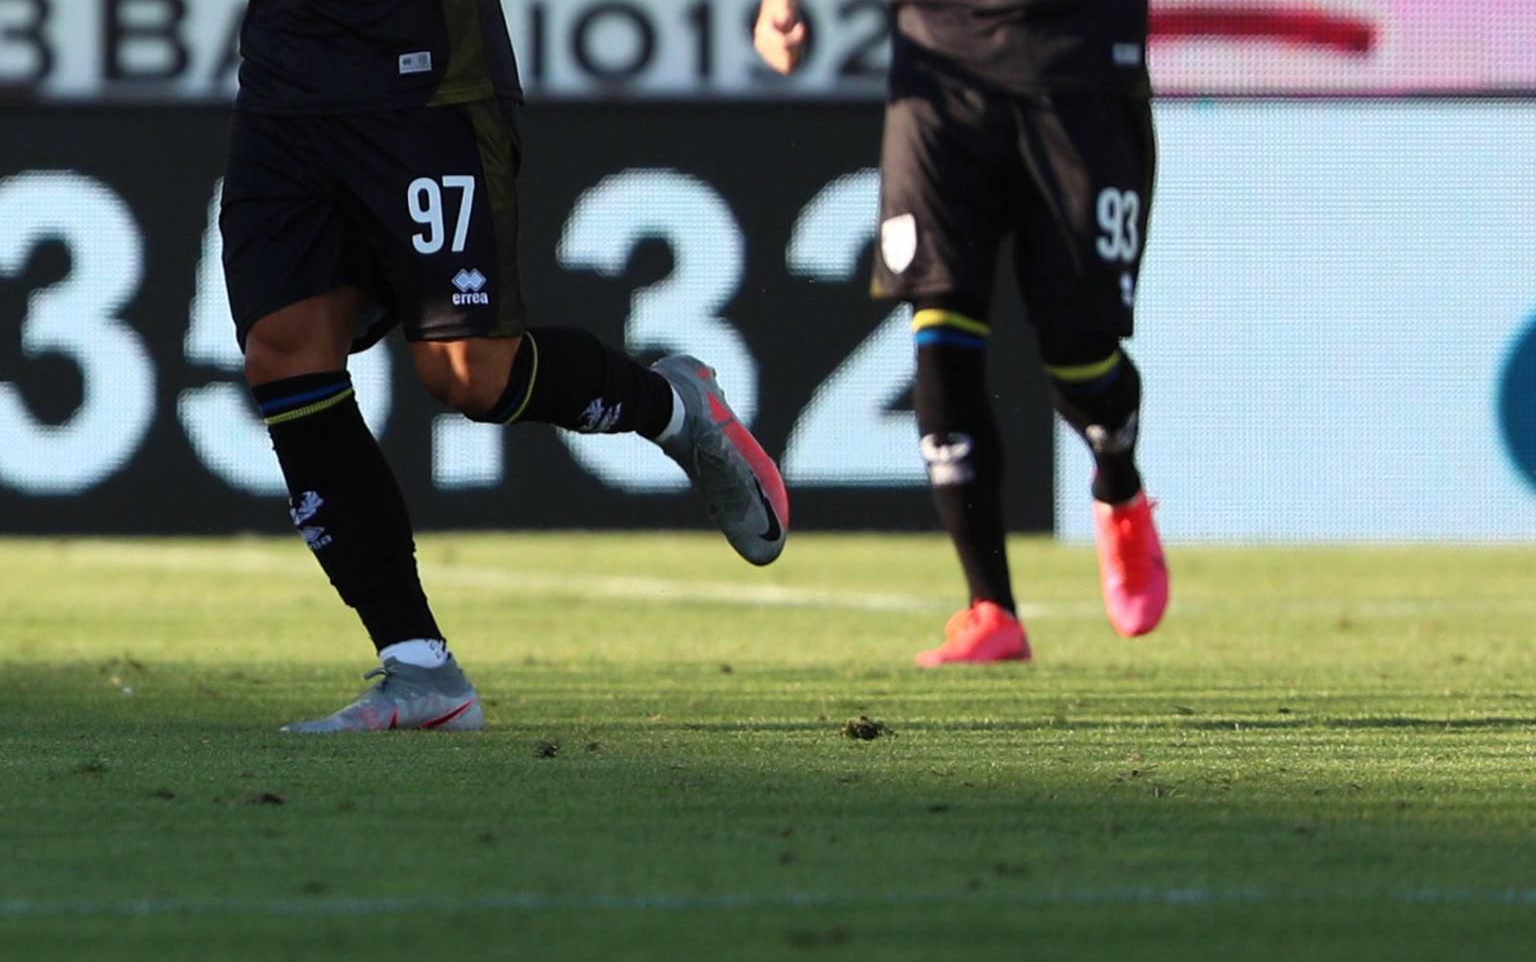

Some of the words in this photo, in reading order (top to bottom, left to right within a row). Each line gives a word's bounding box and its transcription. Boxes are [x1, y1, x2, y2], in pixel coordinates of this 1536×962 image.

[407, 174, 475, 254] 97
[1095, 186, 1140, 263] 93
[452, 292, 488, 305] errea
